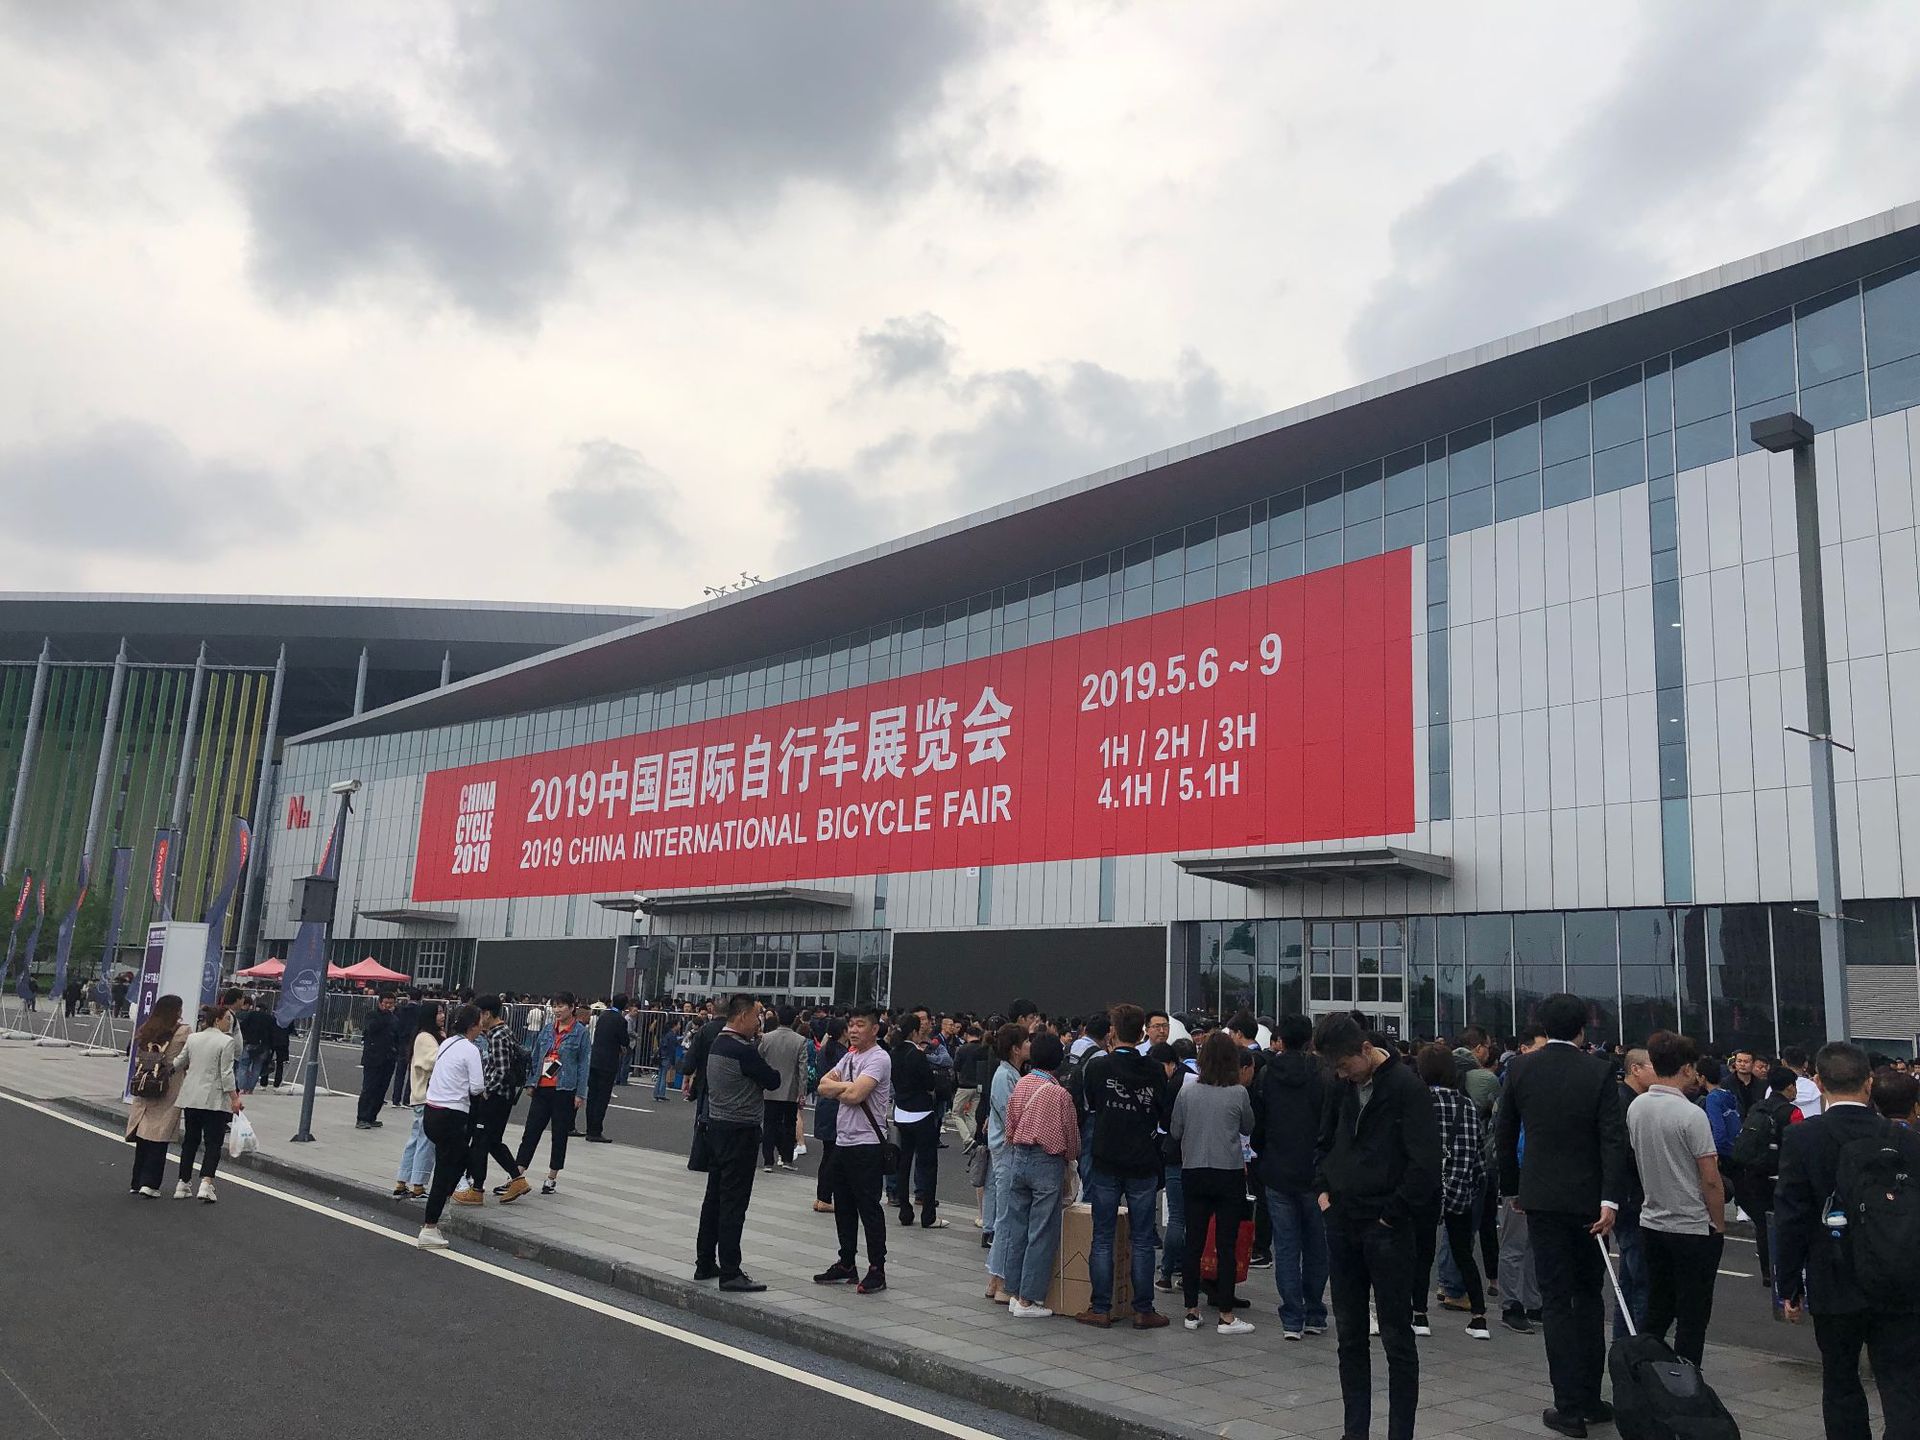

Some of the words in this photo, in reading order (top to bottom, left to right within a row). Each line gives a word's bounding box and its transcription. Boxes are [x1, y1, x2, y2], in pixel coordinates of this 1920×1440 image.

[1080, 646, 1220, 712] 2019.5.6
[1259, 633, 1283, 676] 9
[526, 686, 1013, 823] 2019中国国际自行车展览会
[1099, 735, 1129, 769] 1H
[1138, 729, 1146, 767] /
[1154, 724, 1190, 761] 2H
[1200, 719, 1208, 757] /
[1218, 713, 1257, 753] 3H
[458, 781, 497, 814] CHINA
[1097, 772, 1152, 809] 4.1H
[1161, 768, 1170, 806] /
[1179, 761, 1240, 801] 5.1H
[455, 811, 494, 843] CYCLE
[519, 838, 563, 869] 2019
[568, 832, 626, 866] CHINA
[632, 812, 808, 860] INTERNATIONAL
[817, 795, 932, 843] BICYCLE
[943, 784, 1013, 828] FAIR
[451, 842, 491, 875] 2019
